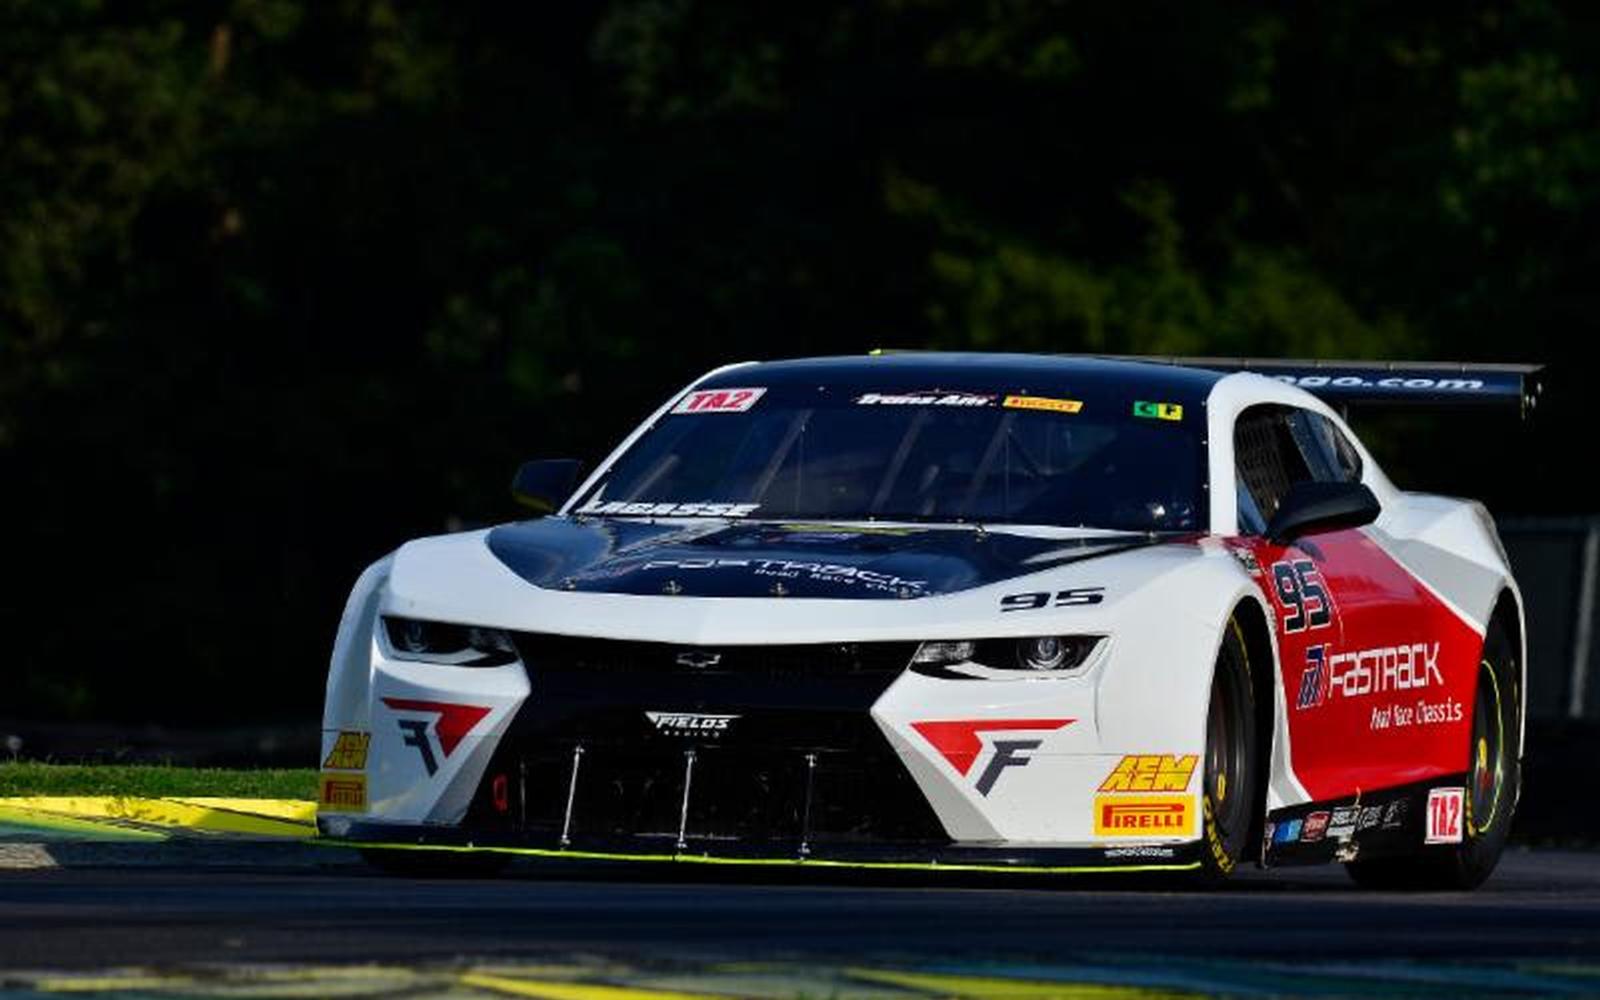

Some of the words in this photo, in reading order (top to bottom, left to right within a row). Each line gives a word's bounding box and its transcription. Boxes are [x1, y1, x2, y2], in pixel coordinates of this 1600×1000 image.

[687, 390, 755, 411] TA2
[574, 484, 762, 517] LAGASSE
[1000, 587, 1105, 612] 95
[1272, 559, 1332, 634] 95
[656, 716, 730, 729] FIELDS
[1096, 754, 1200, 793] AEM
[1101, 803, 1186, 829] PIRELLI
[1430, 794, 1461, 837] TA2
